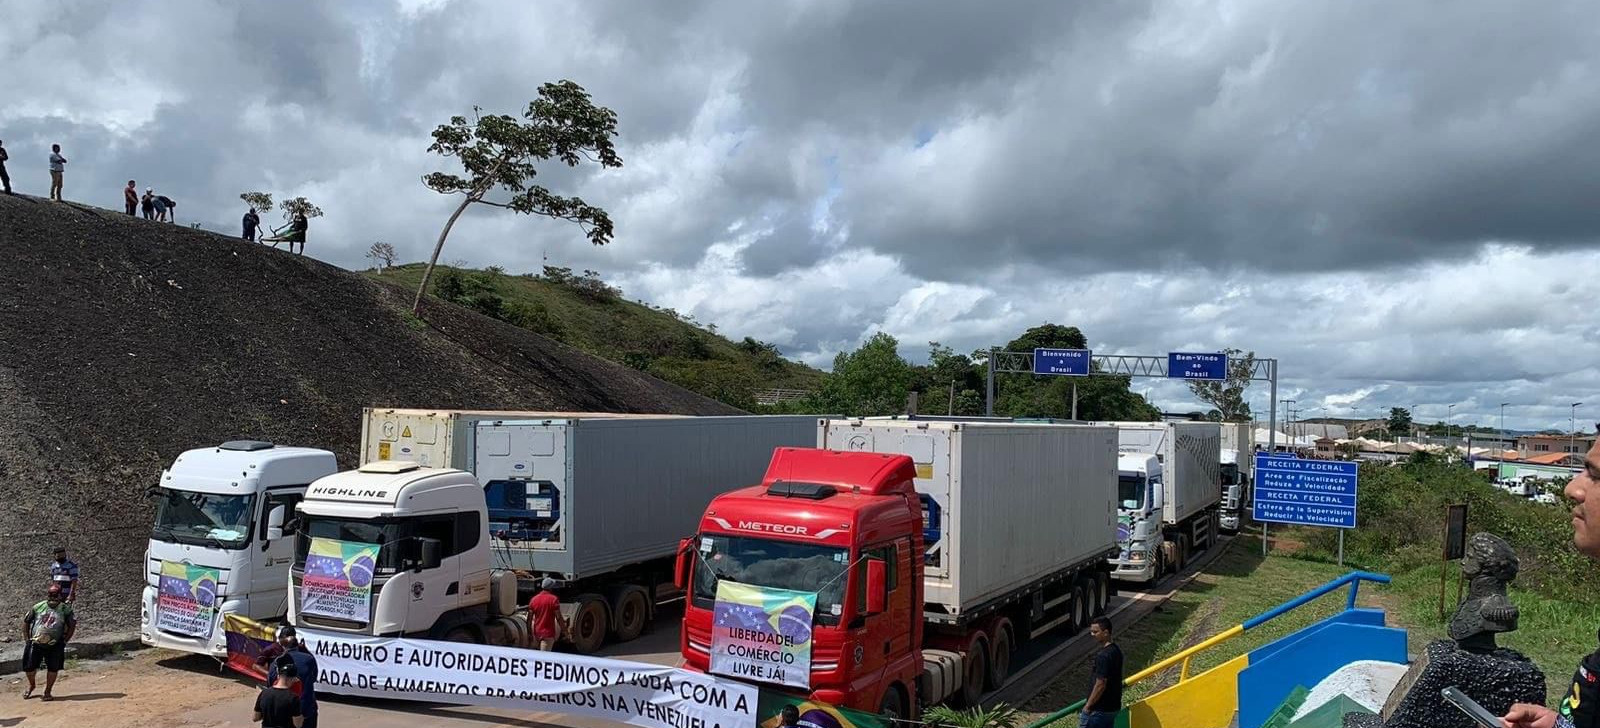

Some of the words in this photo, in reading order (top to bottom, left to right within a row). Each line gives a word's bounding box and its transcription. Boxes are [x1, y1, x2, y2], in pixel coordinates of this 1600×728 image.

[1267, 460, 1301, 468] RECEITA
[1305, 463, 1345, 472] FEDERAL
[1299, 474, 1348, 484] Fiscalização
[313, 487, 388, 498] HIGHLINE
[1304, 482, 1346, 492] Velocidade
[1267, 492, 1298, 500] RECETA
[1303, 495, 1342, 504] FEDERAL
[1257, 503, 1283, 511] Esfera
[1306, 507, 1352, 516] Supervision
[1264, 511, 1293, 519] Reducir
[1306, 514, 1344, 524] Velocidad
[739, 520, 808, 535] METEOR
[729, 626, 794, 648] LIBERDADE!
[727, 644, 795, 665] COMÉRCIO
[315, 640, 388, 663] MADURO
[394, 647, 404, 664] E
[408, 649, 528, 677] AUTORIDADES
[534, 660, 609, 688] PEDIMOS
[680, 681, 728, 709] COM
[733, 694, 749, 715] A
[733, 661, 763, 678] LIVRE
[766, 665, 786, 682] JÁ!
[357, 673, 379, 691] DE
[601, 692, 630, 714] NA
